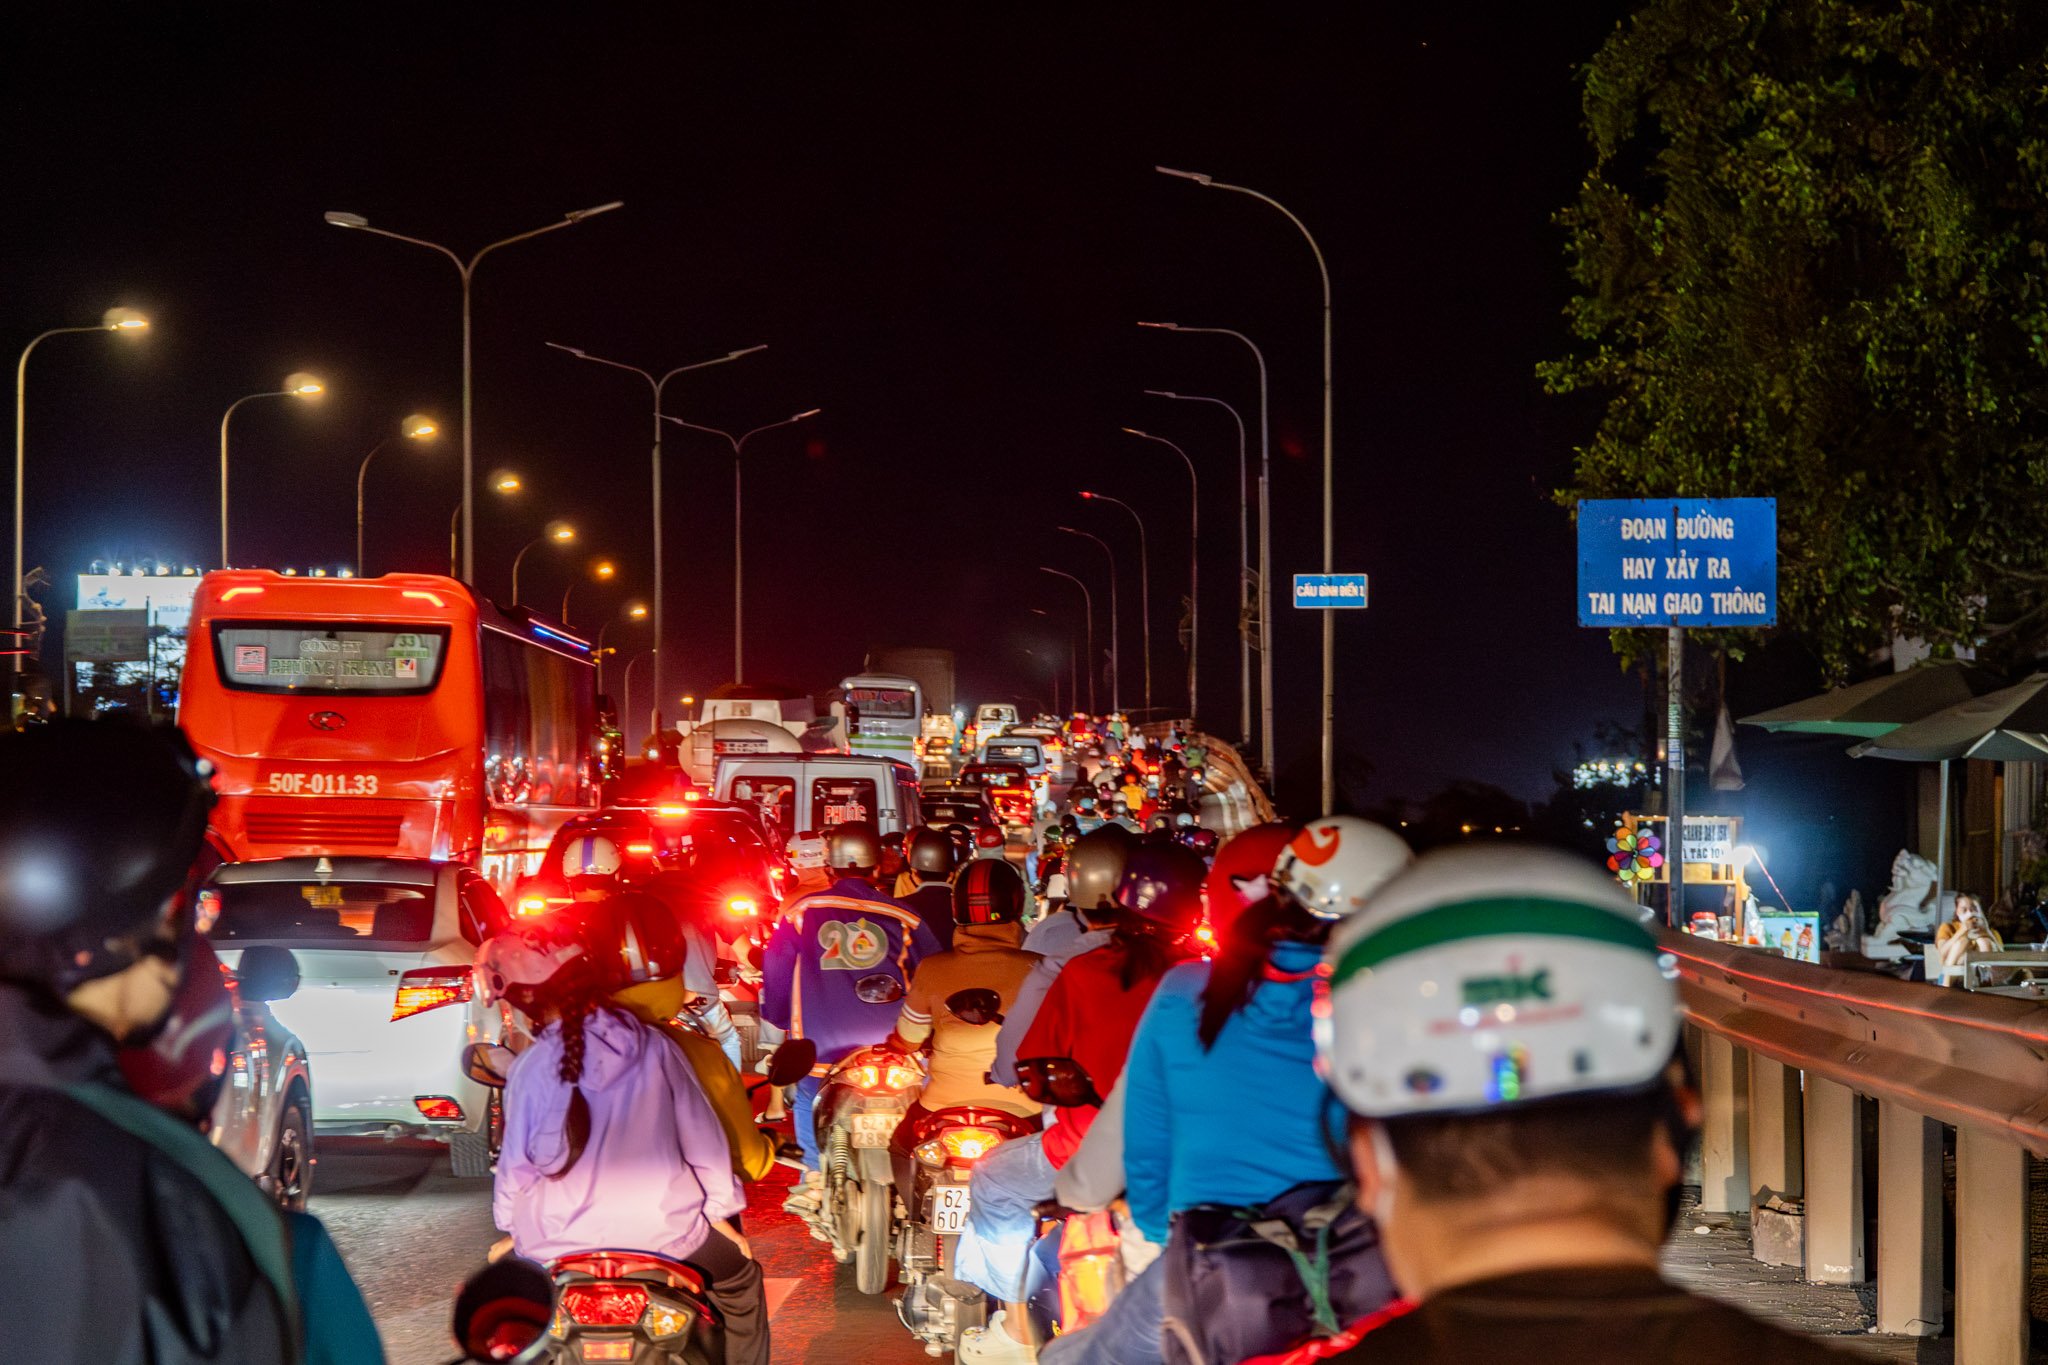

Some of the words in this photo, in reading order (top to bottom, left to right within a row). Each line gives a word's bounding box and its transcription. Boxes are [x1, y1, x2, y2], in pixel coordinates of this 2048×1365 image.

[1621, 517, 1666, 544] ĐOẠN
[1676, 508, 1734, 540] ĐƯỜNG
[1622, 557, 1656, 580] HAY
[1665, 549, 1699, 580] XẢY
[1707, 557, 1731, 580] RA
[1588, 592, 1615, 615] TAI
[1622, 592, 1656, 619] NẠN
[1663, 592, 1703, 615] GIAO
[1710, 585, 1766, 615] THÔNG
[269, 772, 378, 795] 50F-011.33
